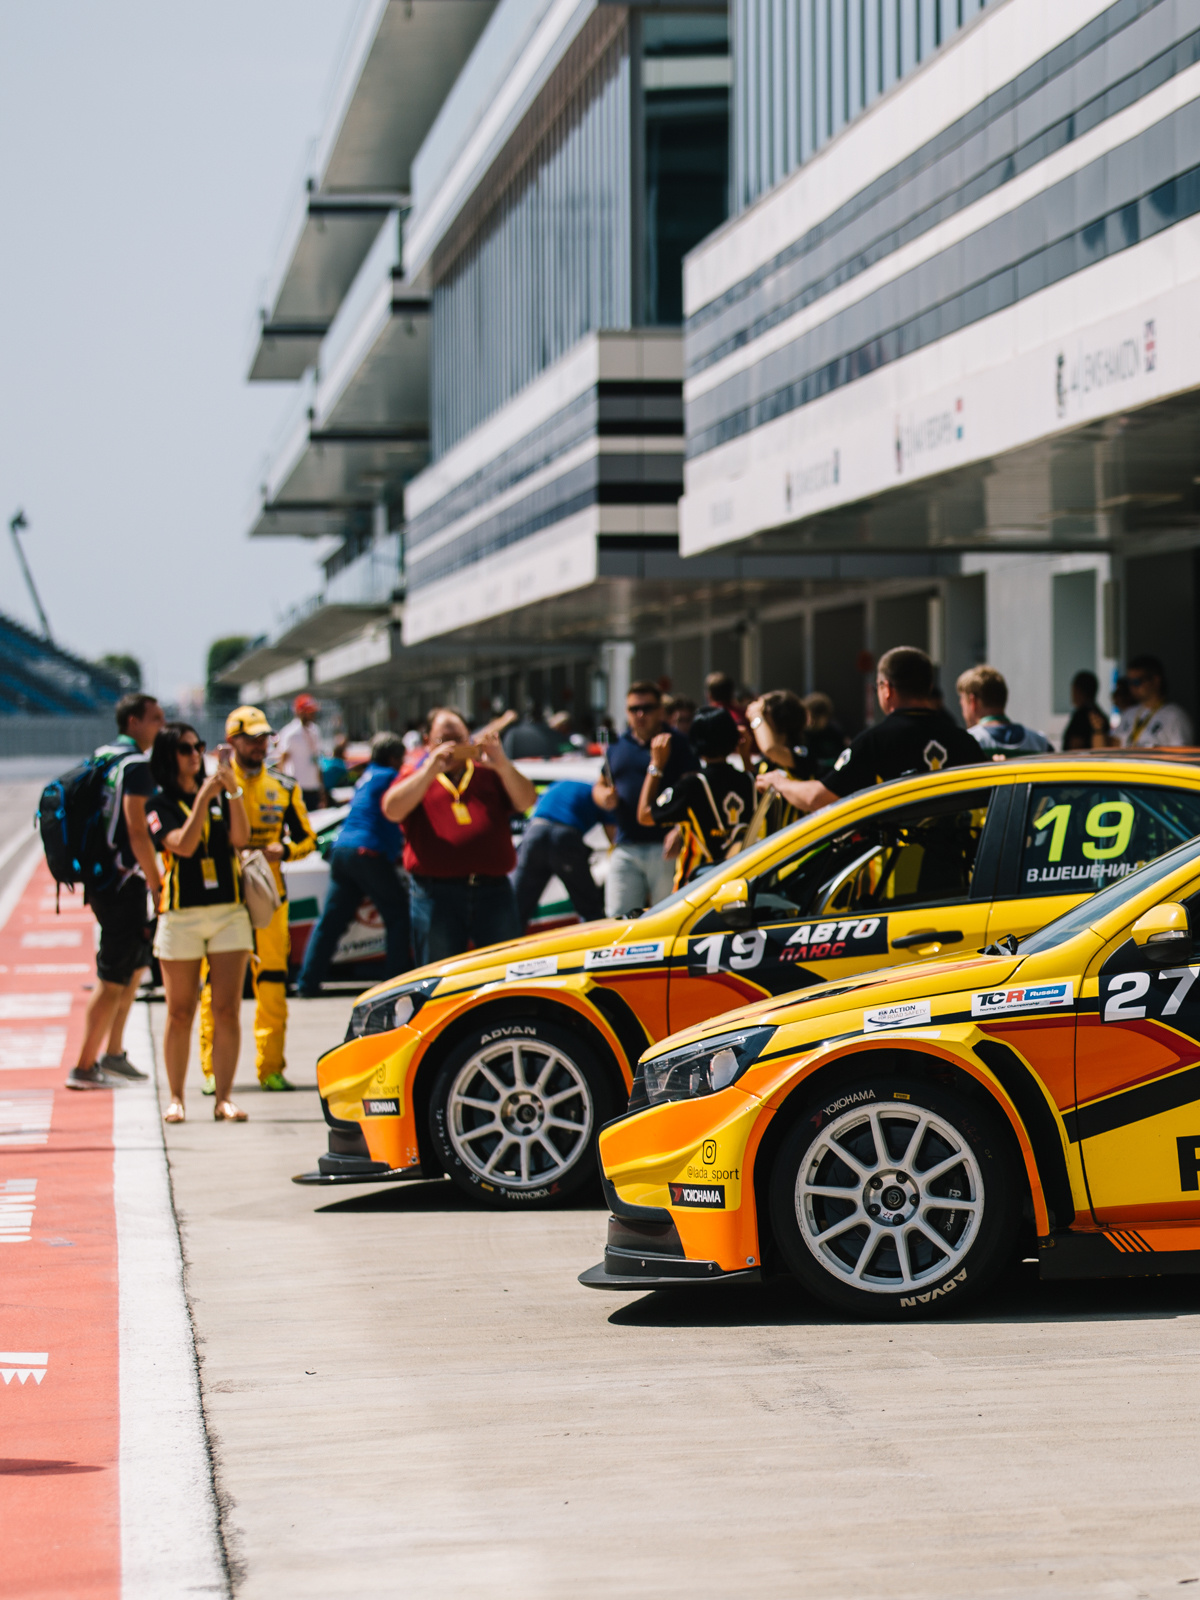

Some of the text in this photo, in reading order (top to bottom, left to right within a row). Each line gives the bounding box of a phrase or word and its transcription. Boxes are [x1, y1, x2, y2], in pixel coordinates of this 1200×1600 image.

[1033, 801, 1135, 862] 19
[785, 917, 881, 946] АВТО
[589, 948, 626, 960] TCR
[693, 929, 767, 974] 19
[778, 942, 846, 962] ПЛЮС
[977, 989, 1059, 1007] TCR Russia
[1104, 966, 1200, 1022] 27
[889, 1004, 916, 1014] ACTION
[480, 1025, 537, 1045] ADVAN
[823, 1089, 876, 1116] YOKOHAMA
[686, 1165, 740, 1181] @lada_sport
[682, 1188, 721, 1203] YOKOHAMA
[900, 1267, 968, 1308] ADVAN
